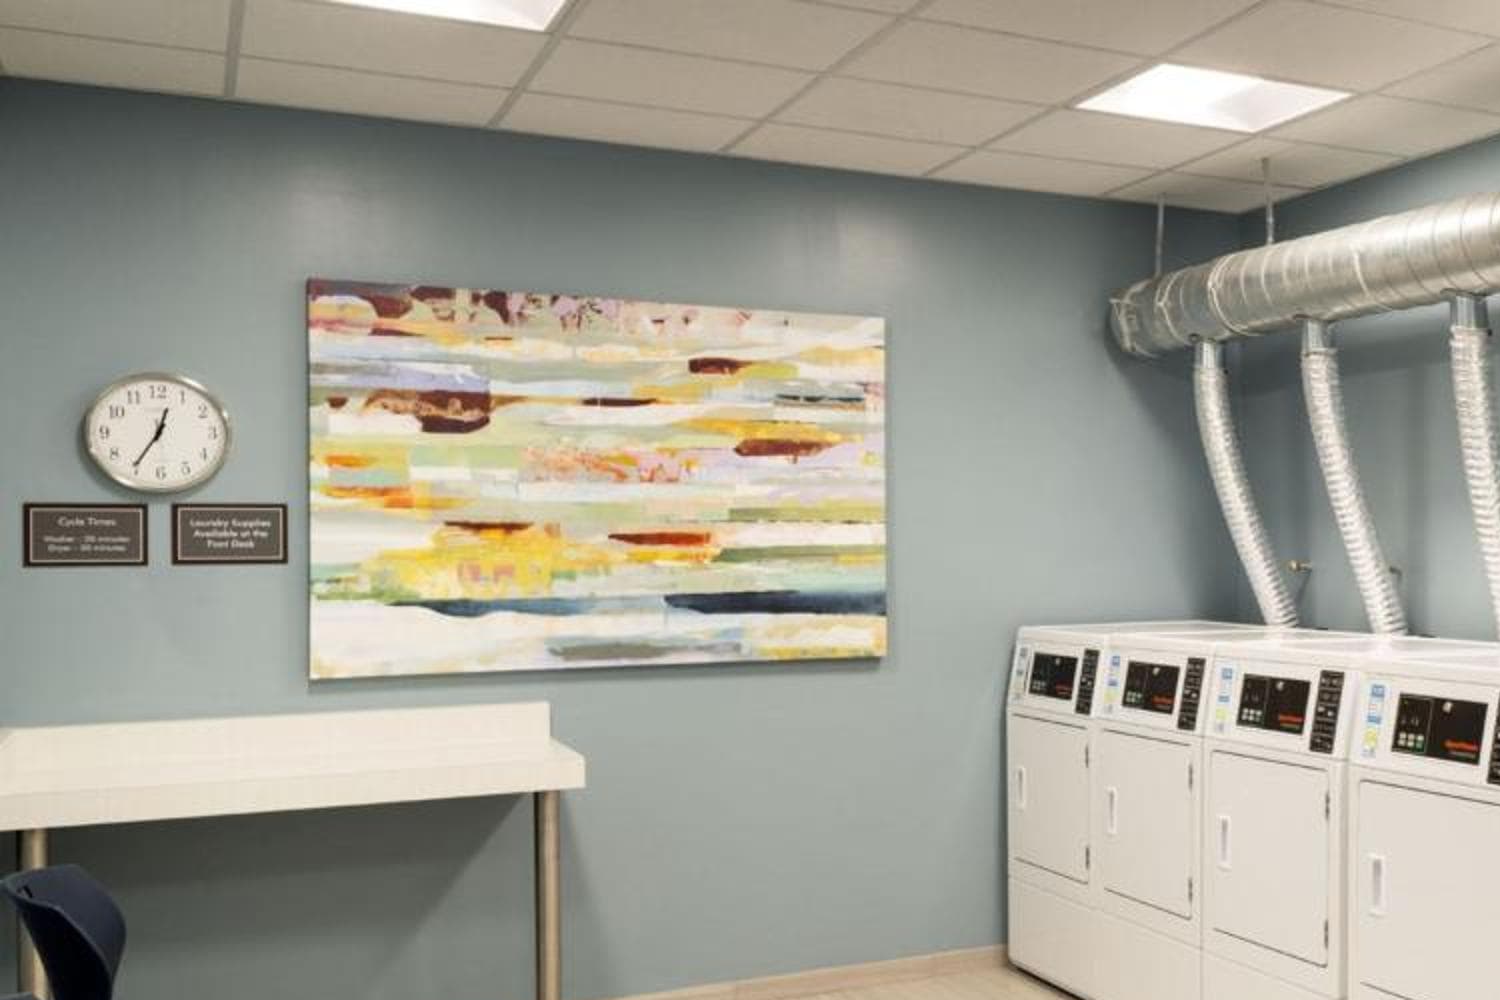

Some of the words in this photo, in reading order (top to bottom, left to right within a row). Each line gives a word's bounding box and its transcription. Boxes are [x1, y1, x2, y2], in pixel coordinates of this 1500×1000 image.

[127, 390, 140, 404] 11
[149, 385, 167, 399] 12
[109, 405, 125, 419] 10
[198, 404, 208, 419] 2
[99, 426, 110, 440] 9
[208, 426, 217, 440] 3
[109, 448, 119, 460] 8
[155, 466, 167, 480] 6
[180, 461, 191, 476] 5
[57, 517, 85, 529] Cycle
[87, 517, 117, 528] Times
[189, 518, 229, 530] Laundry
[231, 518, 271, 529] Supplies
[193, 529, 238, 538] Available
[231, 539, 255, 549] Desk
